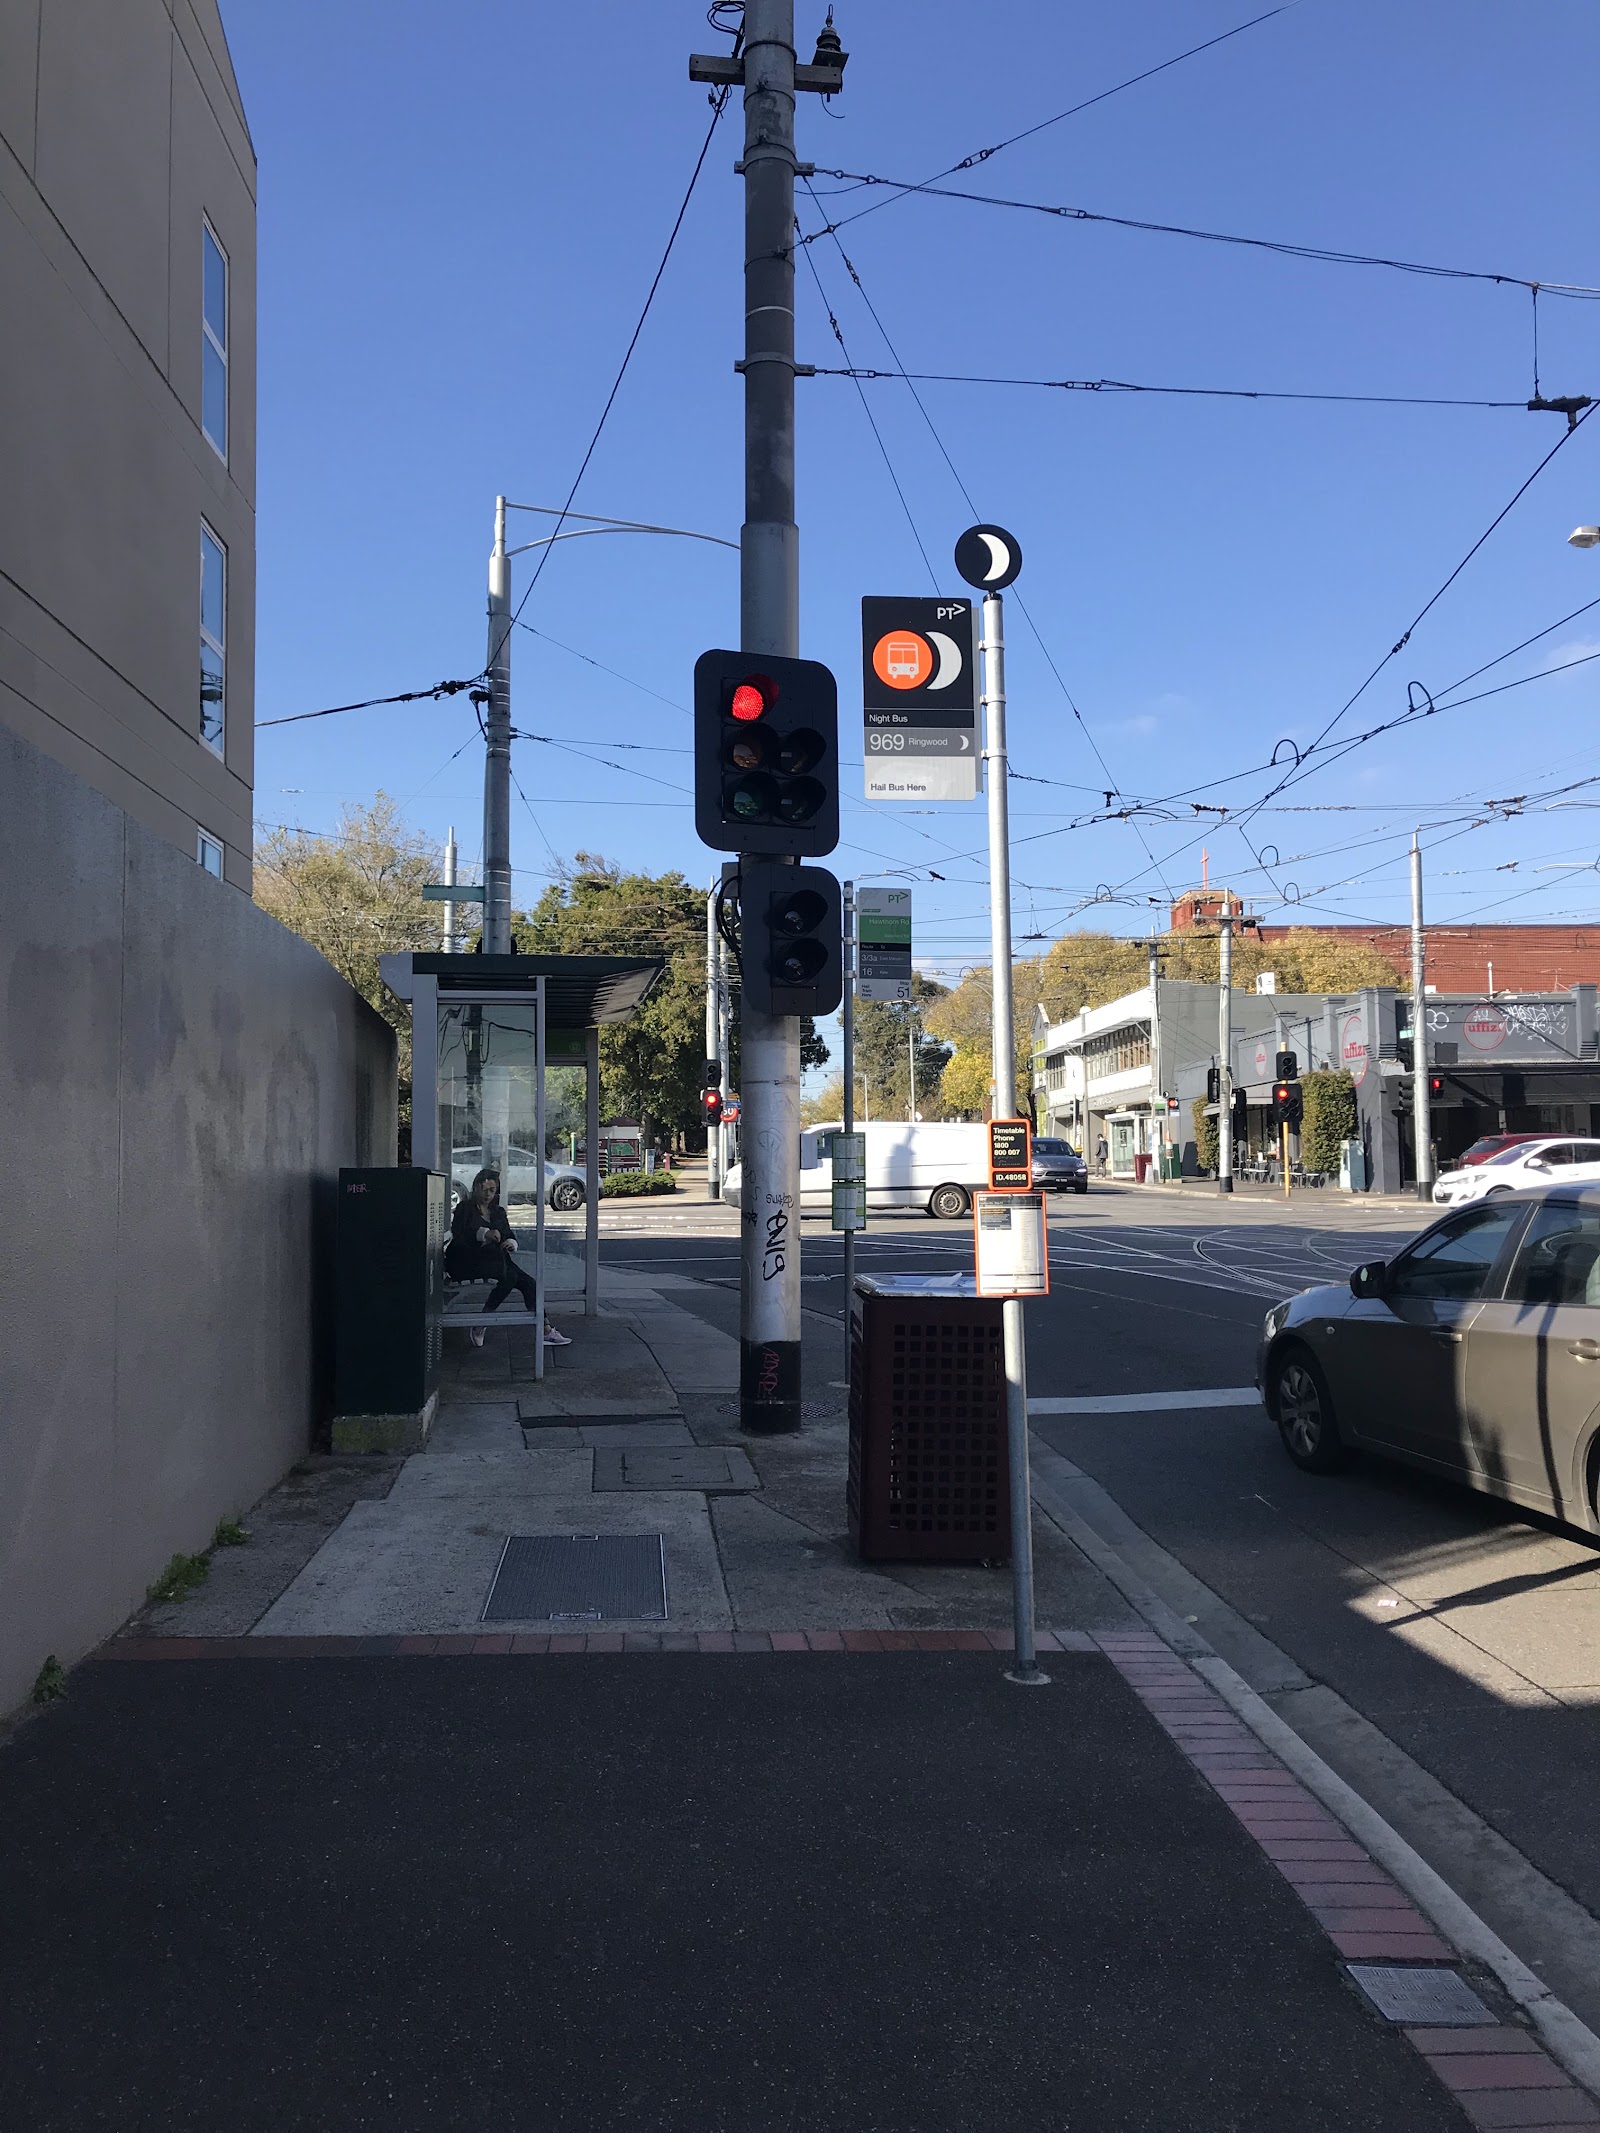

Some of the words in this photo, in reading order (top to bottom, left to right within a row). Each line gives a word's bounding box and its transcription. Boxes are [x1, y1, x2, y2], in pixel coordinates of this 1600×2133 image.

[868, 713, 891, 725] Night
[892, 714, 908, 723] Bus
[869, 733, 905, 751] 969
[908, 737, 948, 748] Ringwood
[870, 783, 887, 791] Hail
[888, 783, 905, 791] Bus
[906, 783, 927, 791] Here
[868, 917, 899, 925] Hawthorn
[900, 918, 910, 926] Rd
[861, 954, 878, 962] 3/3a
[862, 967, 873, 976] 16
[896, 986, 910, 998] 51
[993, 1134, 1015, 1142] Phone
